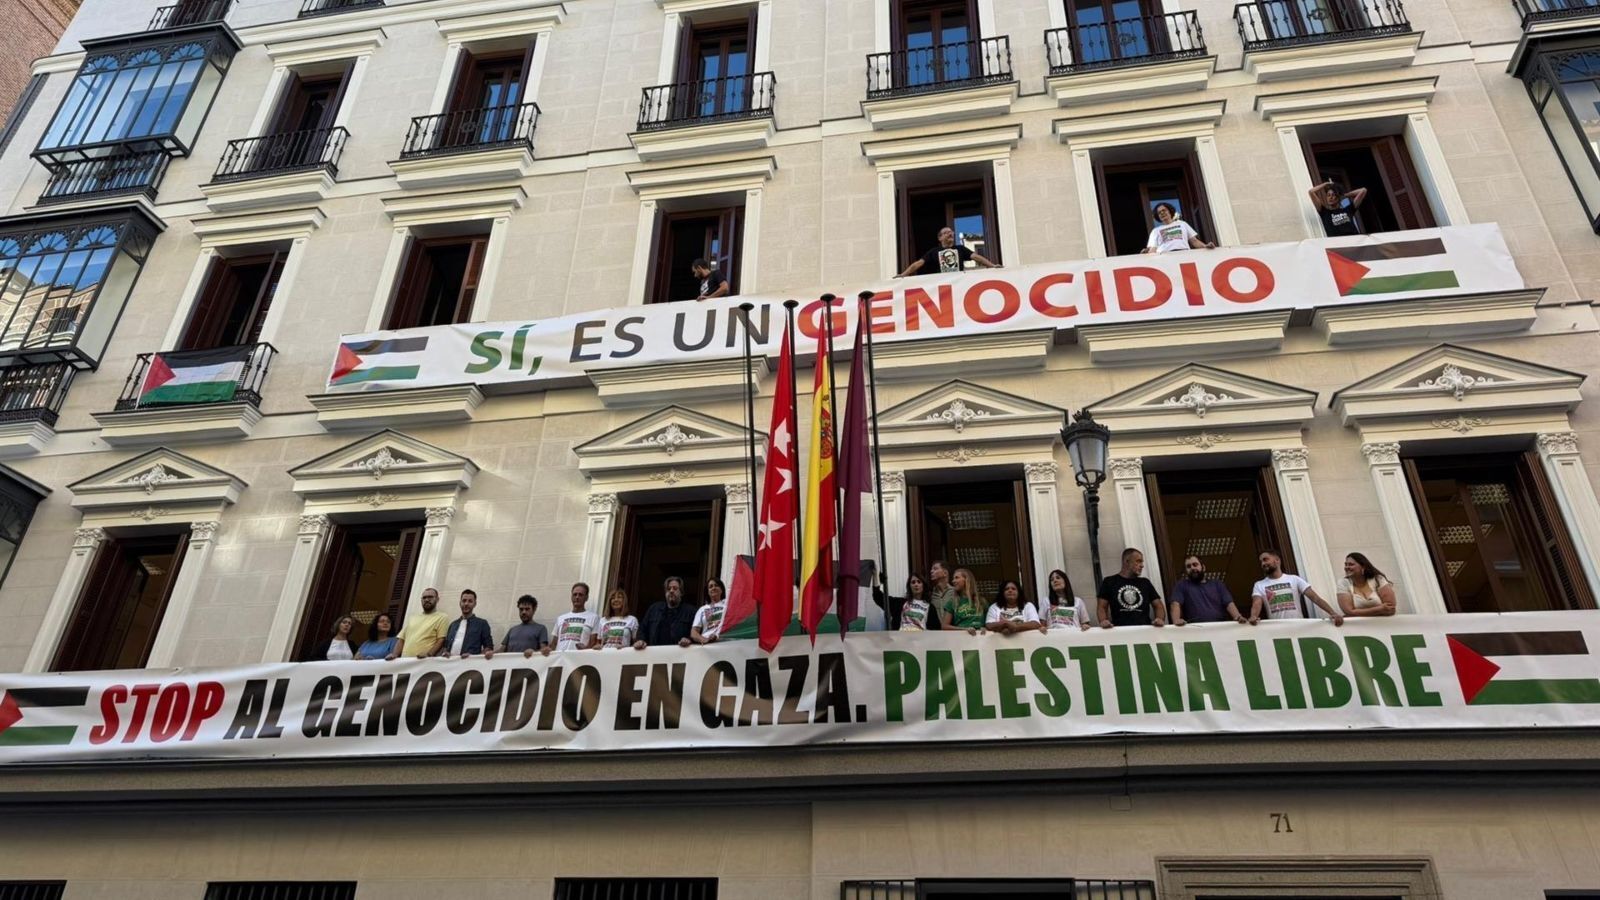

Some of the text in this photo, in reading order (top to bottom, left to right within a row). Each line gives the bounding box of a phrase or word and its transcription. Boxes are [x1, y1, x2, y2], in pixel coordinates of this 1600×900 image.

[465, 257, 1275, 376] SÍ, ES UN GENOCIDIO
[88, 634, 1443, 745] STOP AL GENOCIDIO EN GAZA. PALESTINA LIBRE
[1270, 813, 1293, 833] 71
